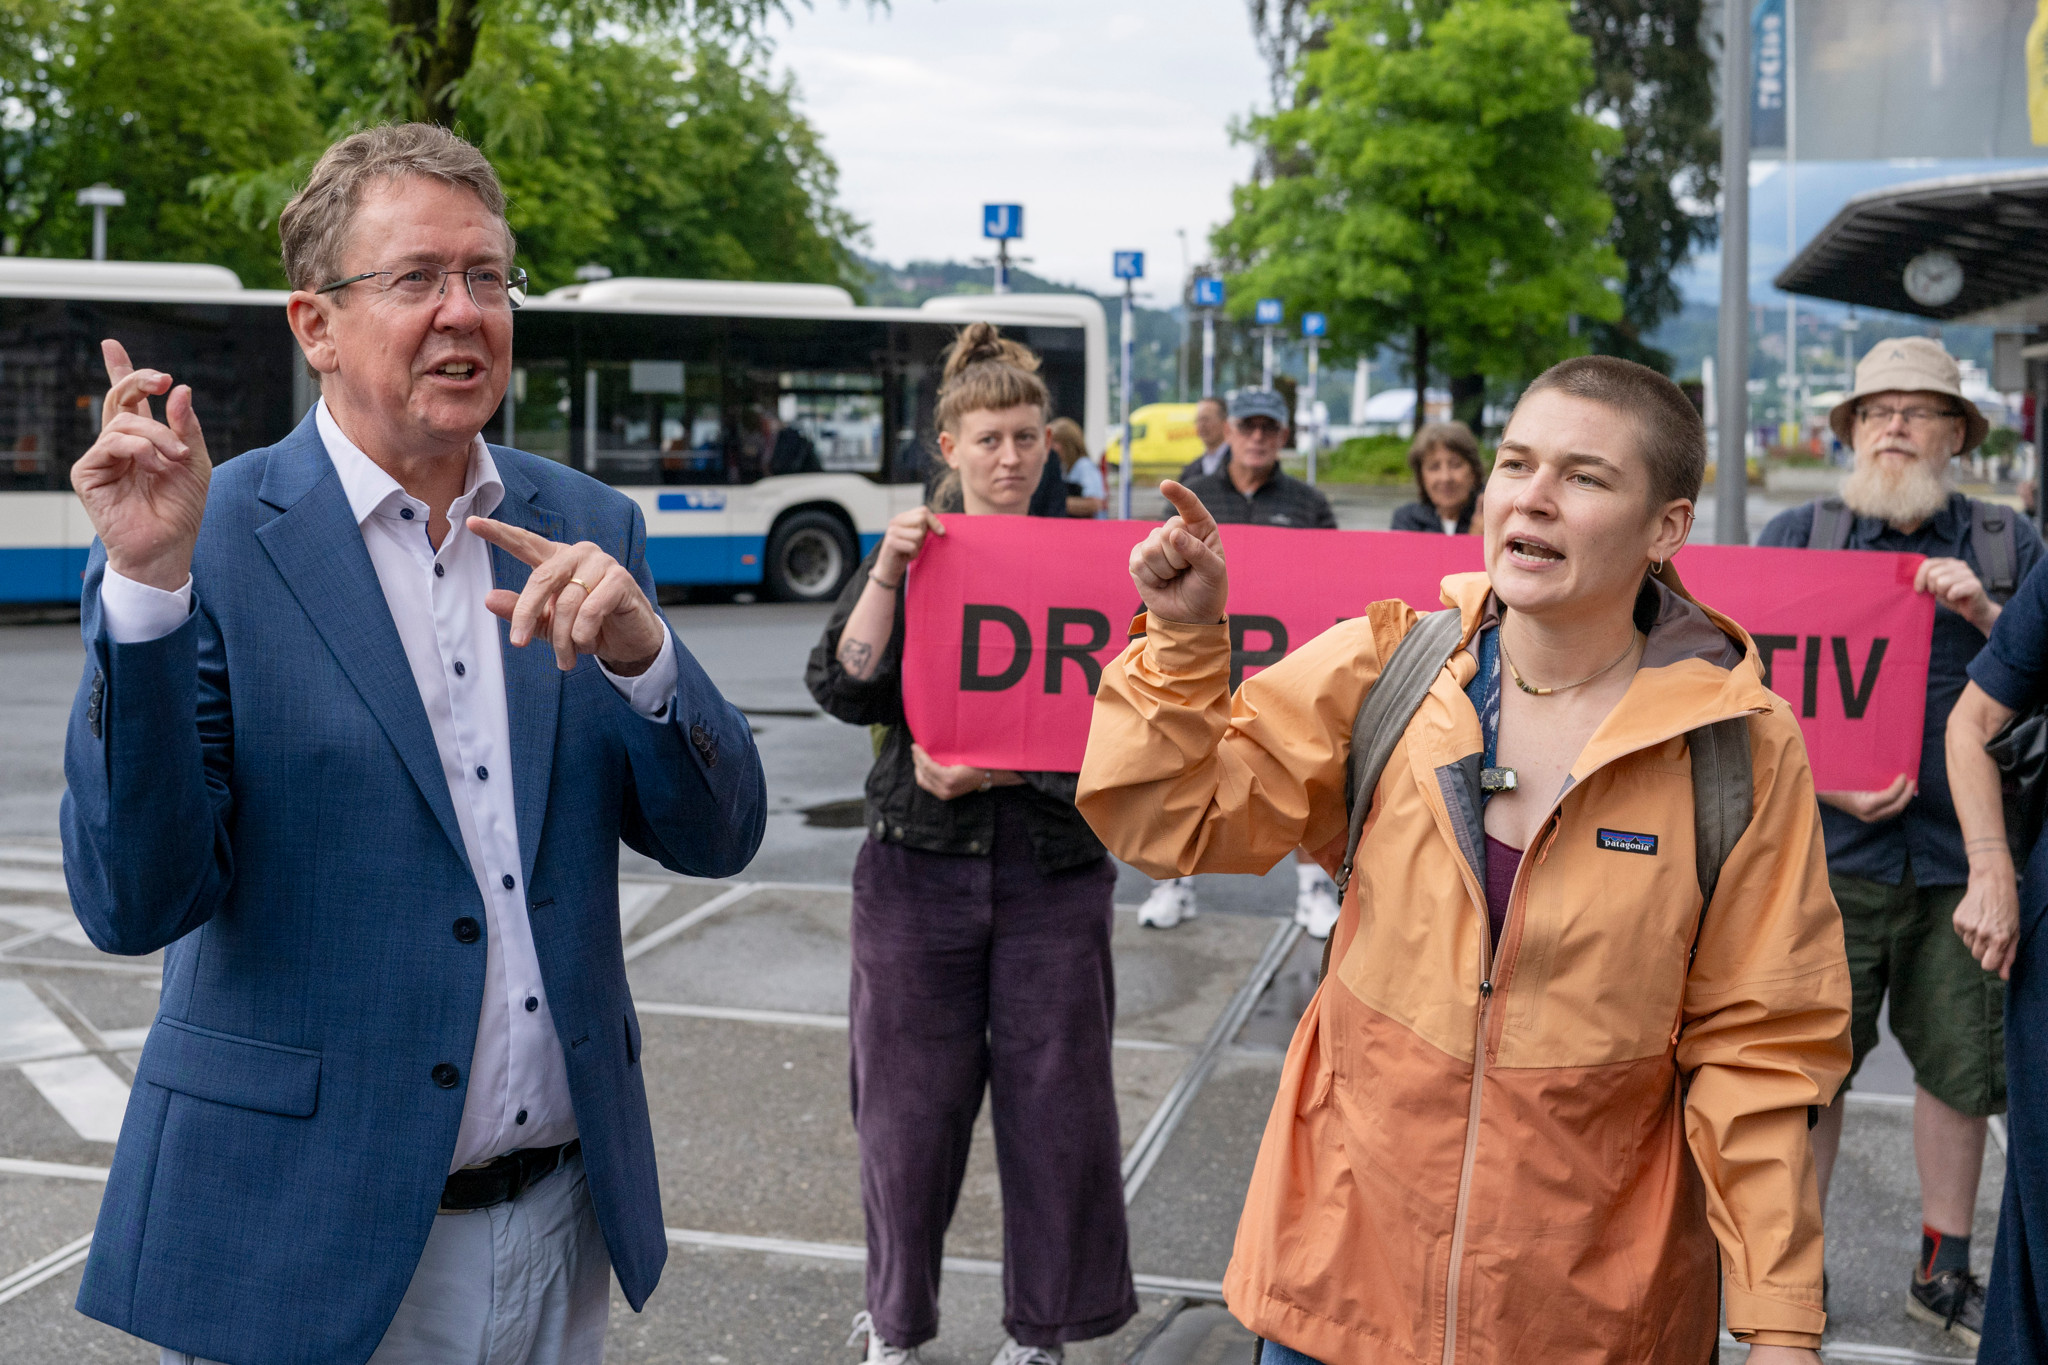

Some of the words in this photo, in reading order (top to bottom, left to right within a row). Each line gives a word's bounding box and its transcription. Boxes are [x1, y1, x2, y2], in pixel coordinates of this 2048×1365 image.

[987, 206, 1009, 236] J
[1117, 254, 1136, 276] K
[1201, 280, 1218, 301] L
[959, 603, 1289, 698] DRP
[1604, 839, 1650, 851] patagonia
